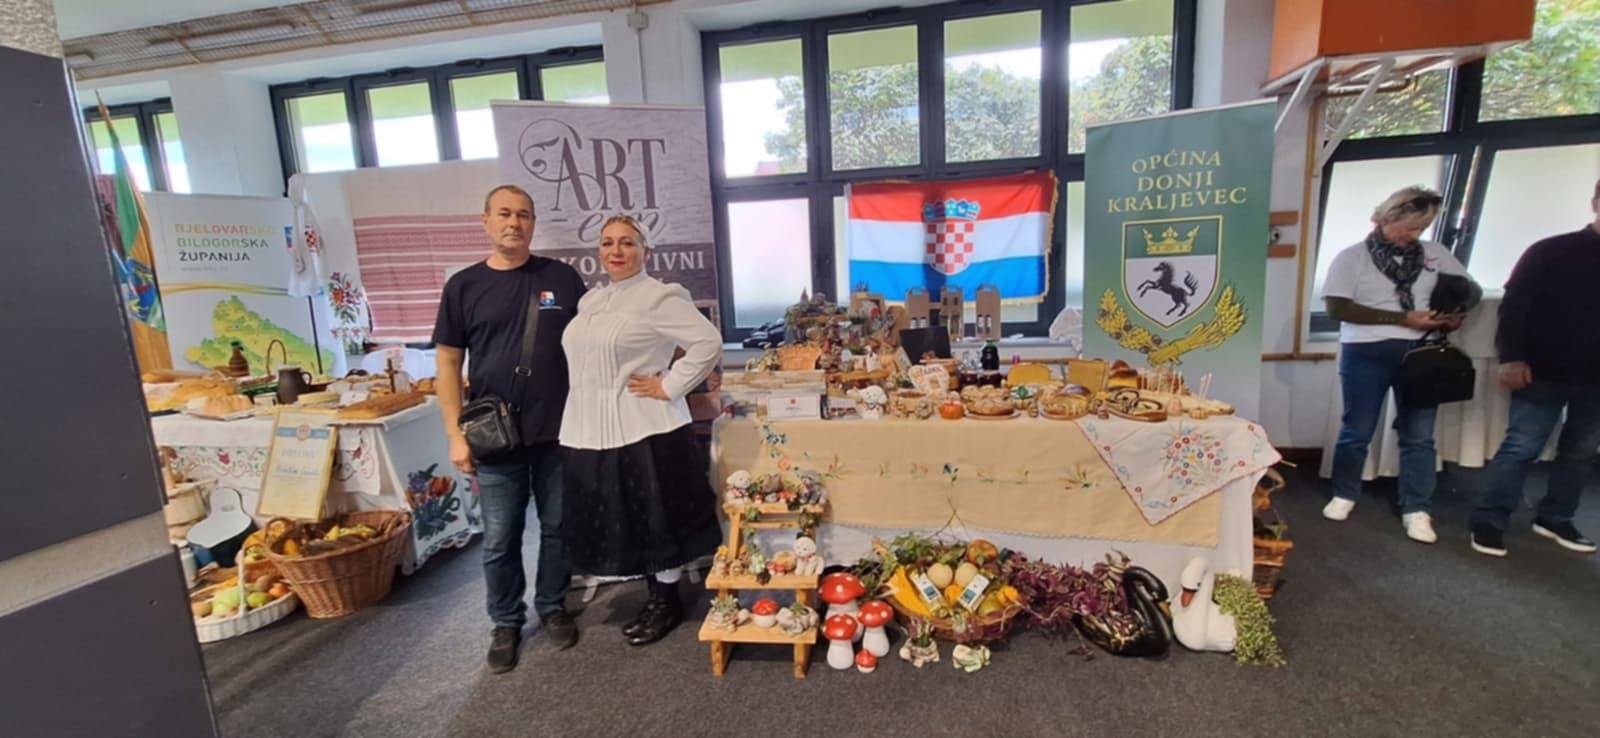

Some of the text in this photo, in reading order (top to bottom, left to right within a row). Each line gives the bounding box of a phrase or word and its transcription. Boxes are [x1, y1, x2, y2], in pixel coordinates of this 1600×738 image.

[519, 118, 665, 211] ART
[1131, 149, 1222, 174] OPĆINA
[1137, 170, 1213, 192] DONJI
[1107, 187, 1247, 213] KRALJEVEC
[177, 237, 269, 249] BILOGORSKA
[179, 249, 251, 261] ŽUPANIJA
